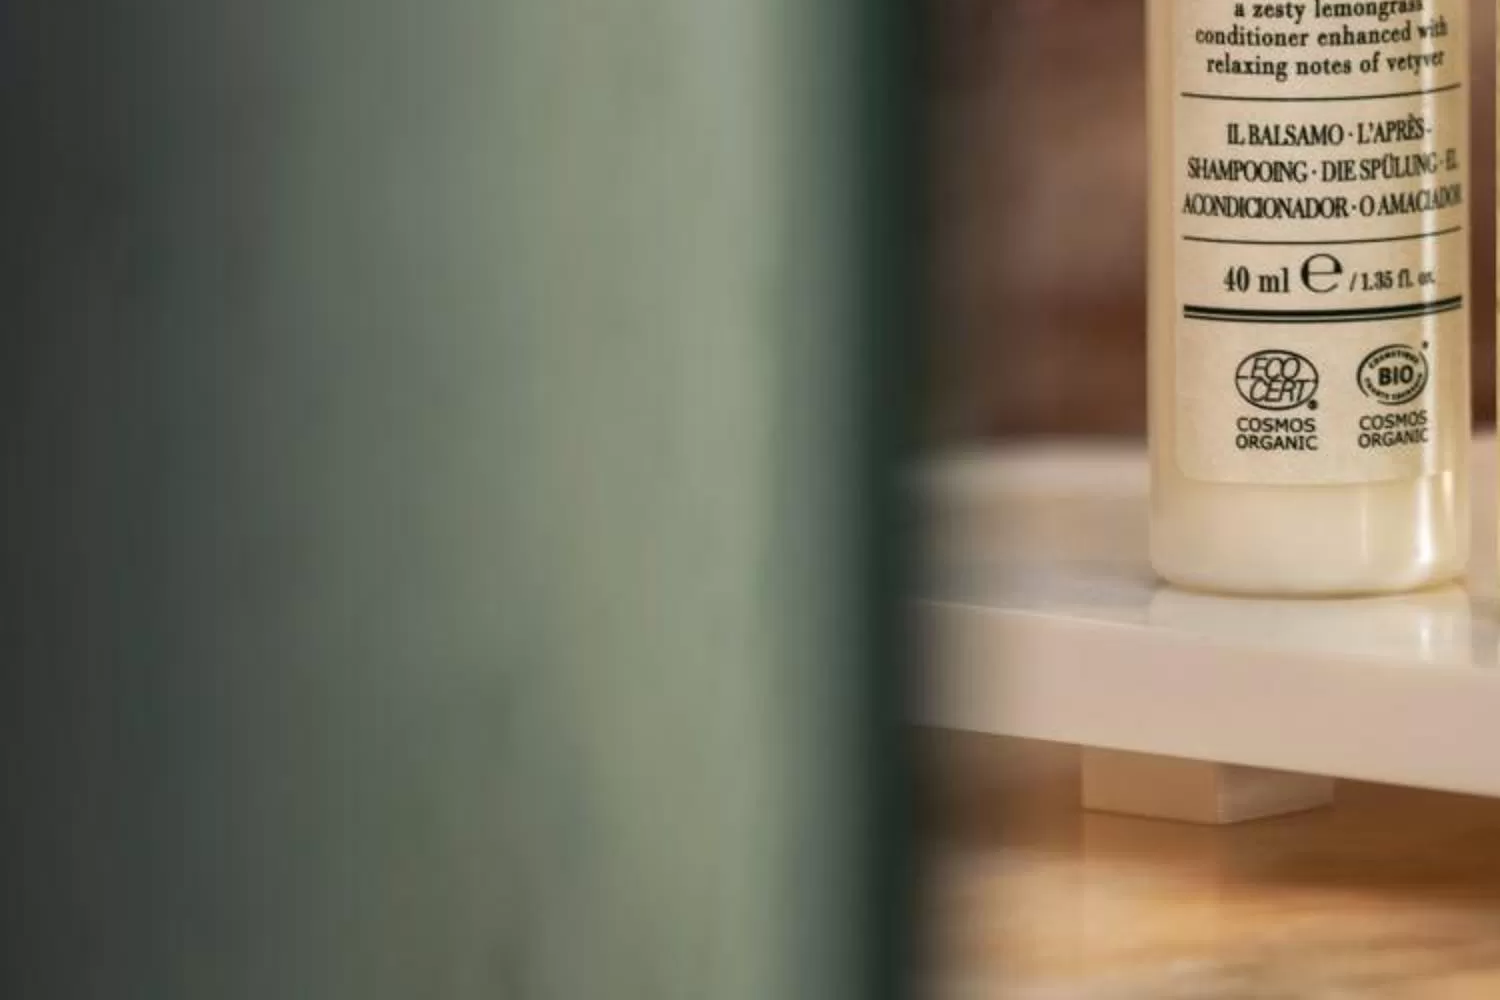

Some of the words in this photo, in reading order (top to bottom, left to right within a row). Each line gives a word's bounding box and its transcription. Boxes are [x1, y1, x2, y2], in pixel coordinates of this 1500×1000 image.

[1234, 4, 1245, 18] a
[1253, 1, 1305, 24] zesty
[1195, 27, 1308, 47] conditioner
[1317, 20, 1411, 45] enhanced
[1207, 54, 1288, 82] relaxing
[1296, 53, 1351, 75] notes
[1360, 54, 1379, 74] of
[1387, 49, 1445, 75] vetyver
[1227, 124, 1245, 145] IL
[1248, 123, 1344, 146] BALSAMO
[1188, 156, 1307, 182] SHAMPOOING
[1322, 160, 1357, 182] DIE
[1359, 148, 1437, 180] SPÜLUNG
[1183, 193, 1349, 219] ACONDICIONADOR
[1359, 196, 1375, 217] O
[1377, 184, 1461, 215] AMACIADOR
[1223, 266, 1249, 292] 40
[1258, 267, 1289, 293] ml
[1251, 357, 1302, 379] ECO
[1378, 365, 1413, 386] BIO
[1248, 380, 1307, 402] CERT
[1237, 417, 1315, 433] COSMOS
[1359, 409, 1428, 431] COSMOS
[1236, 435, 1318, 451] ORGANIC
[1357, 427, 1429, 449] ORGANIC
